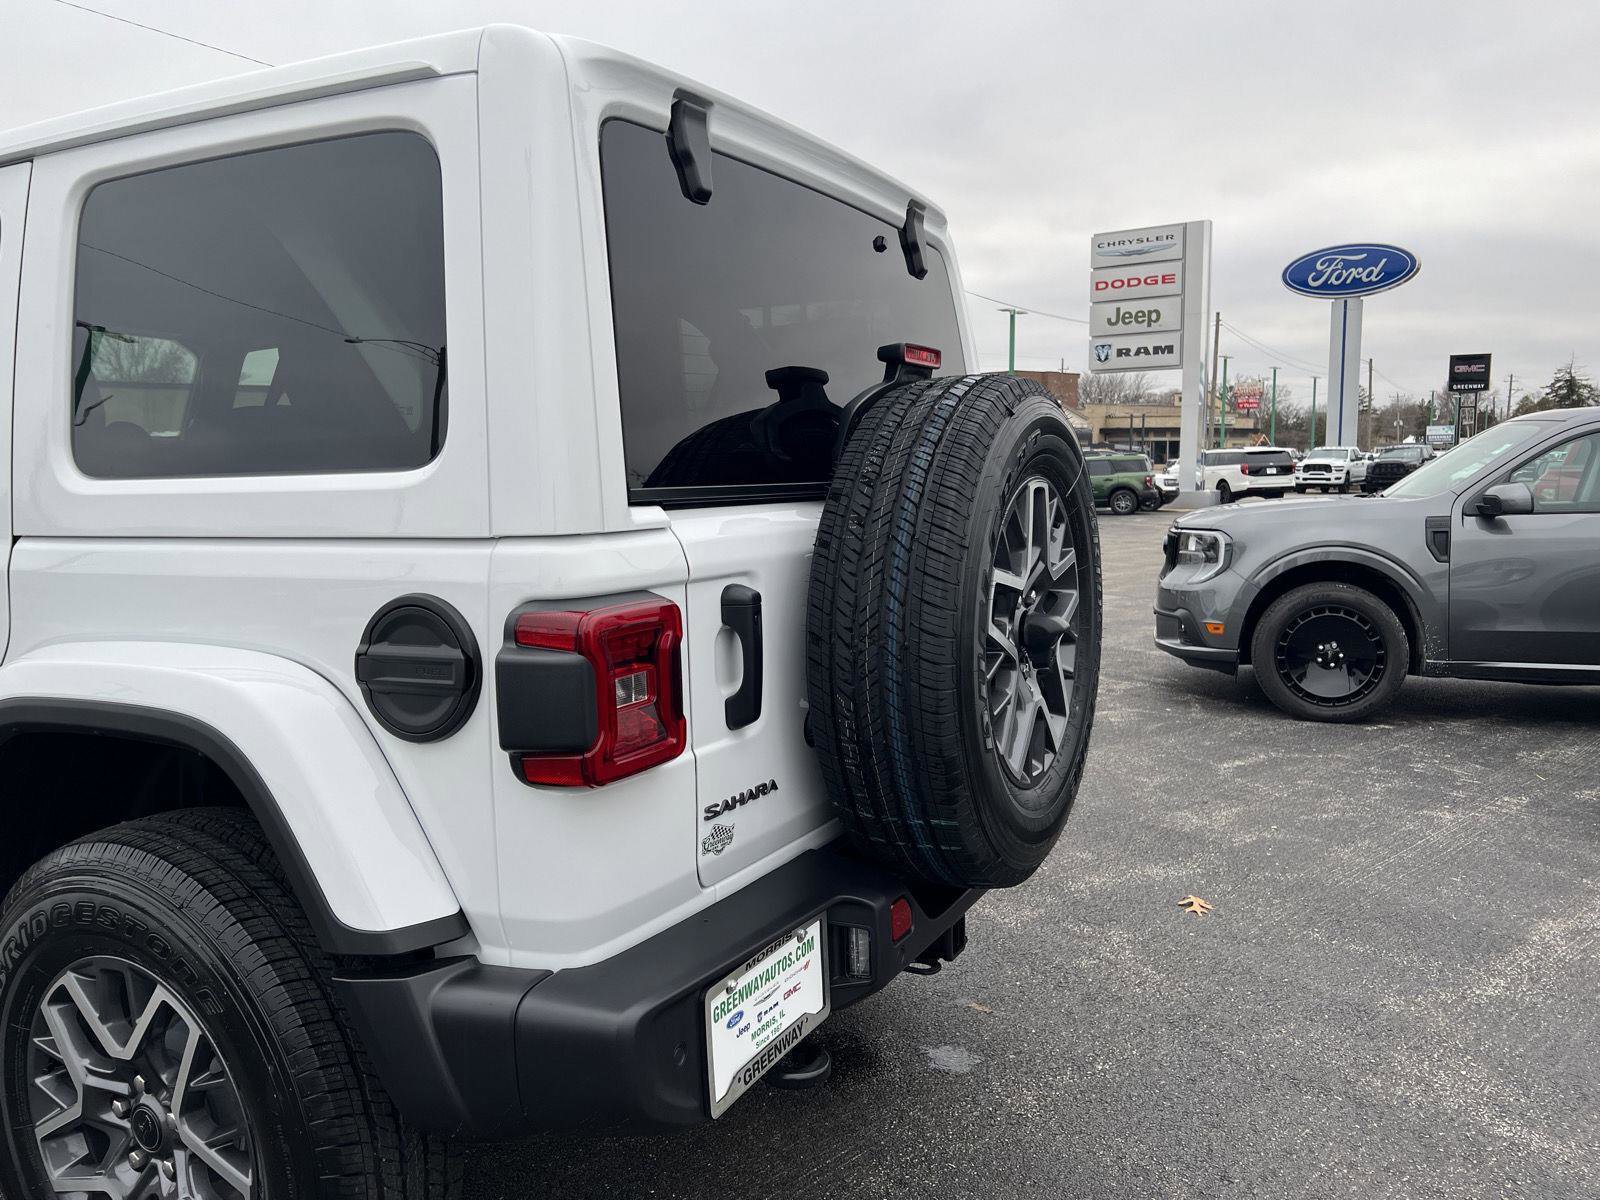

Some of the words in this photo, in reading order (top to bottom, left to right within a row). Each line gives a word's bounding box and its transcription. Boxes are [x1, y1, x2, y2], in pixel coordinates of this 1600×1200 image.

[1097, 234, 1175, 248] CHRYSLER
[1307, 253, 1387, 288] Ford
[1095, 273, 1176, 291] DODGE
[1106, 306, 1161, 328] Jeep
[1116, 344, 1174, 358] RAM
[1454, 364, 1485, 373] GMC
[703, 778, 779, 821] SAHARA
[0, 901, 224, 1016] RIDGESTONE
[744, 933, 793, 971] MORRIS
[713, 935, 815, 1024] GREENWAYAUTOS.COM
[783, 981, 801, 1001] GMC
[779, 1008, 786, 1020] IL
[736, 1022, 751, 1039] Jeep
[755, 1034, 770, 1049] Since
[743, 1020, 804, 1086] GREENWAY
